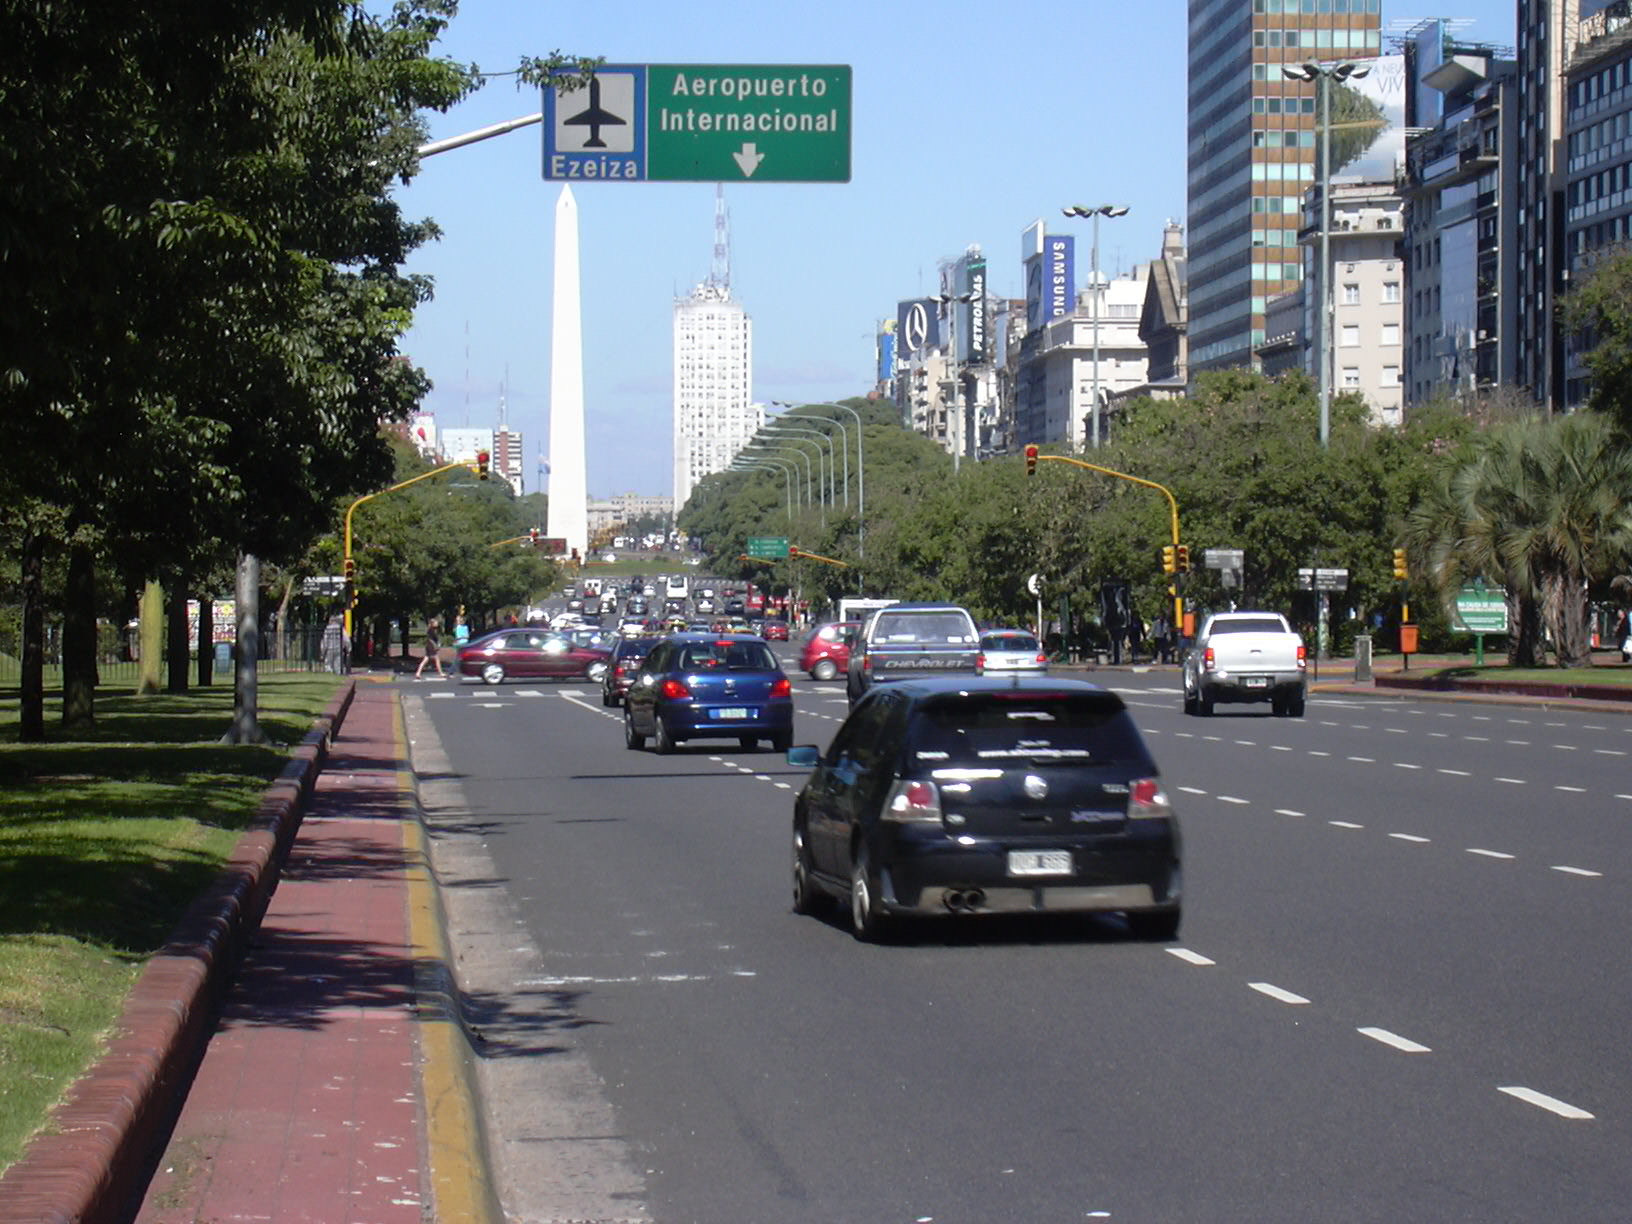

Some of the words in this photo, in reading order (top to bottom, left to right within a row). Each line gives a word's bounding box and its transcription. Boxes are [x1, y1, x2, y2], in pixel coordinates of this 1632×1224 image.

[672, 73, 827, 101] Aeropuerto
[661, 108, 837, 131] Internacional
[551, 155, 637, 178] Ezeiza
[1053, 242, 1066, 316] SAMSUNG
[885, 659, 964, 668] CHEVROLET
